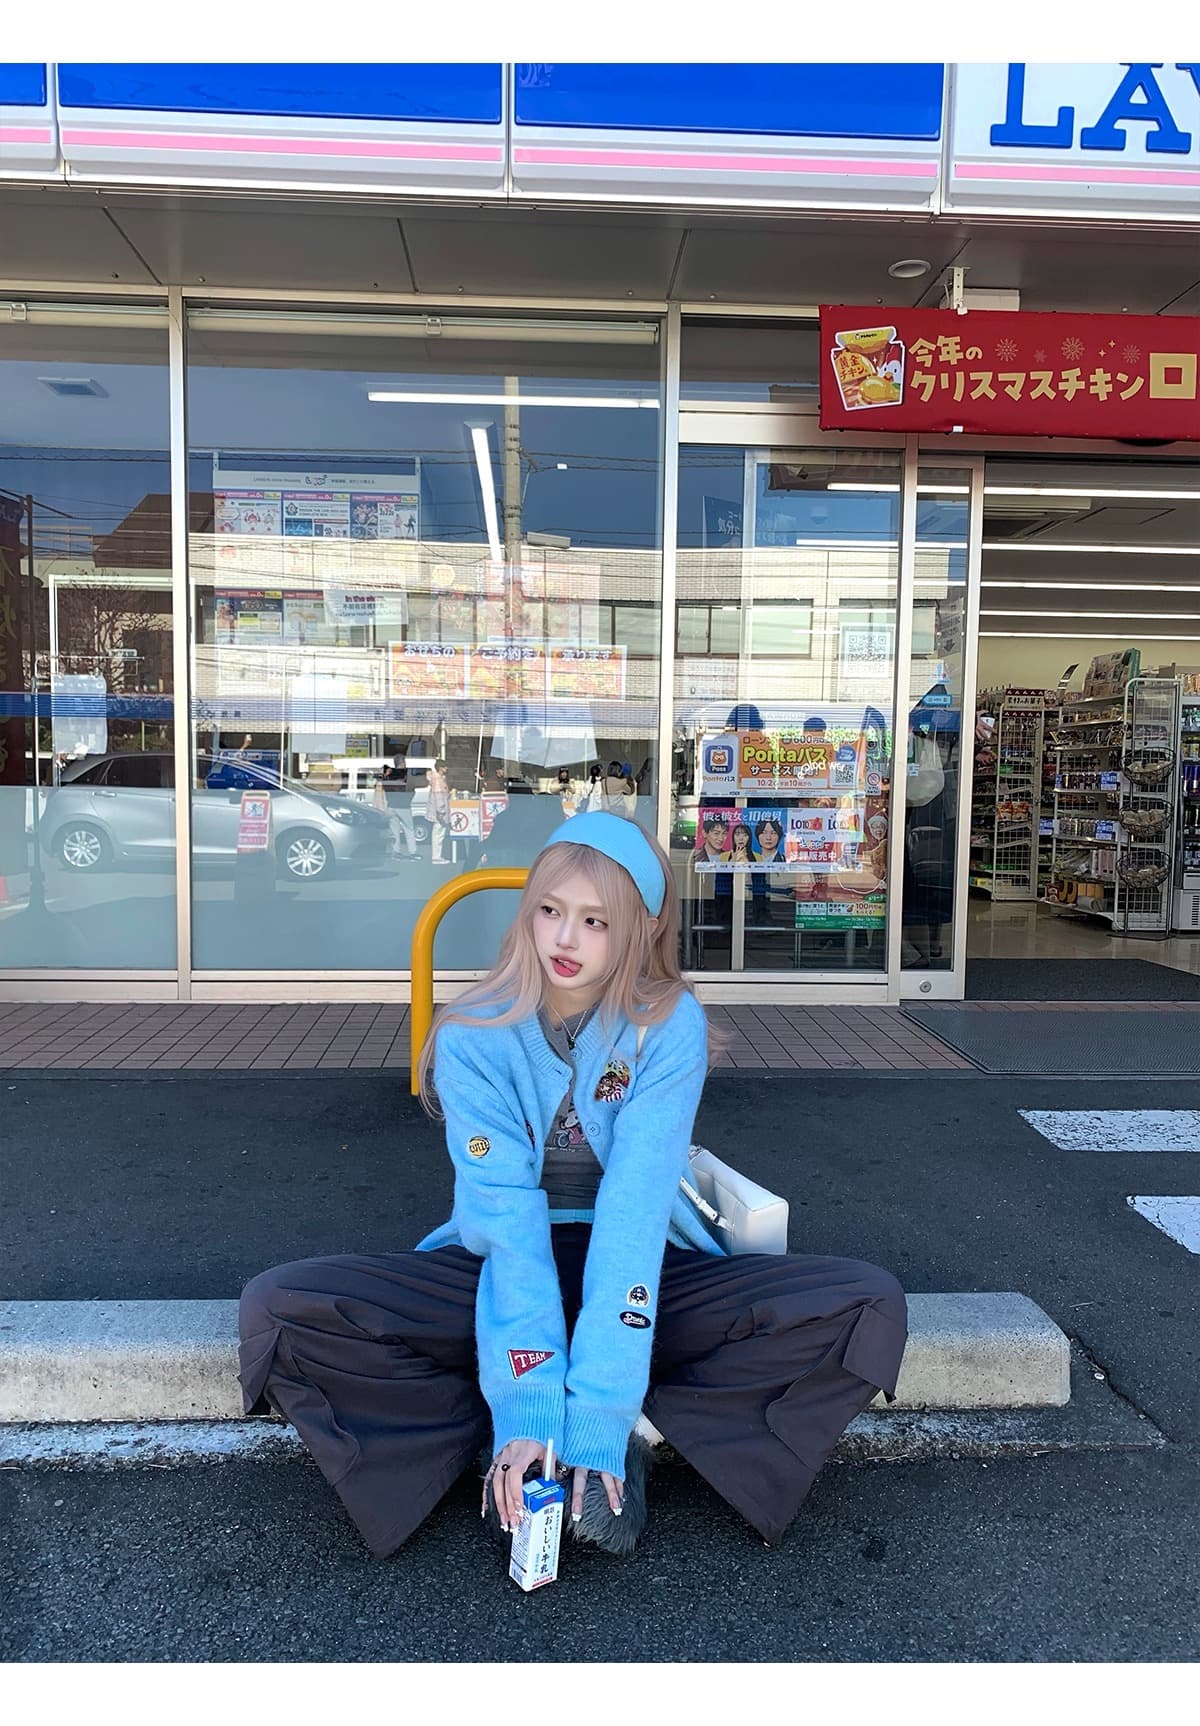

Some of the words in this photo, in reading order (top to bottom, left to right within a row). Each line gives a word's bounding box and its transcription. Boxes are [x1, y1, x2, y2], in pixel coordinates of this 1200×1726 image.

[990, 63, 1200, 154] LA
[908, 335, 983, 367] 今年の
[910, 367, 1145, 402] クリスマスチキン
[404, 646, 455, 658] おせちの
[743, 746, 827, 764] Pontaパス
[515, 1352, 546, 1368] TEAM
[541, 1515, 553, 1574] おいしい牛乳
